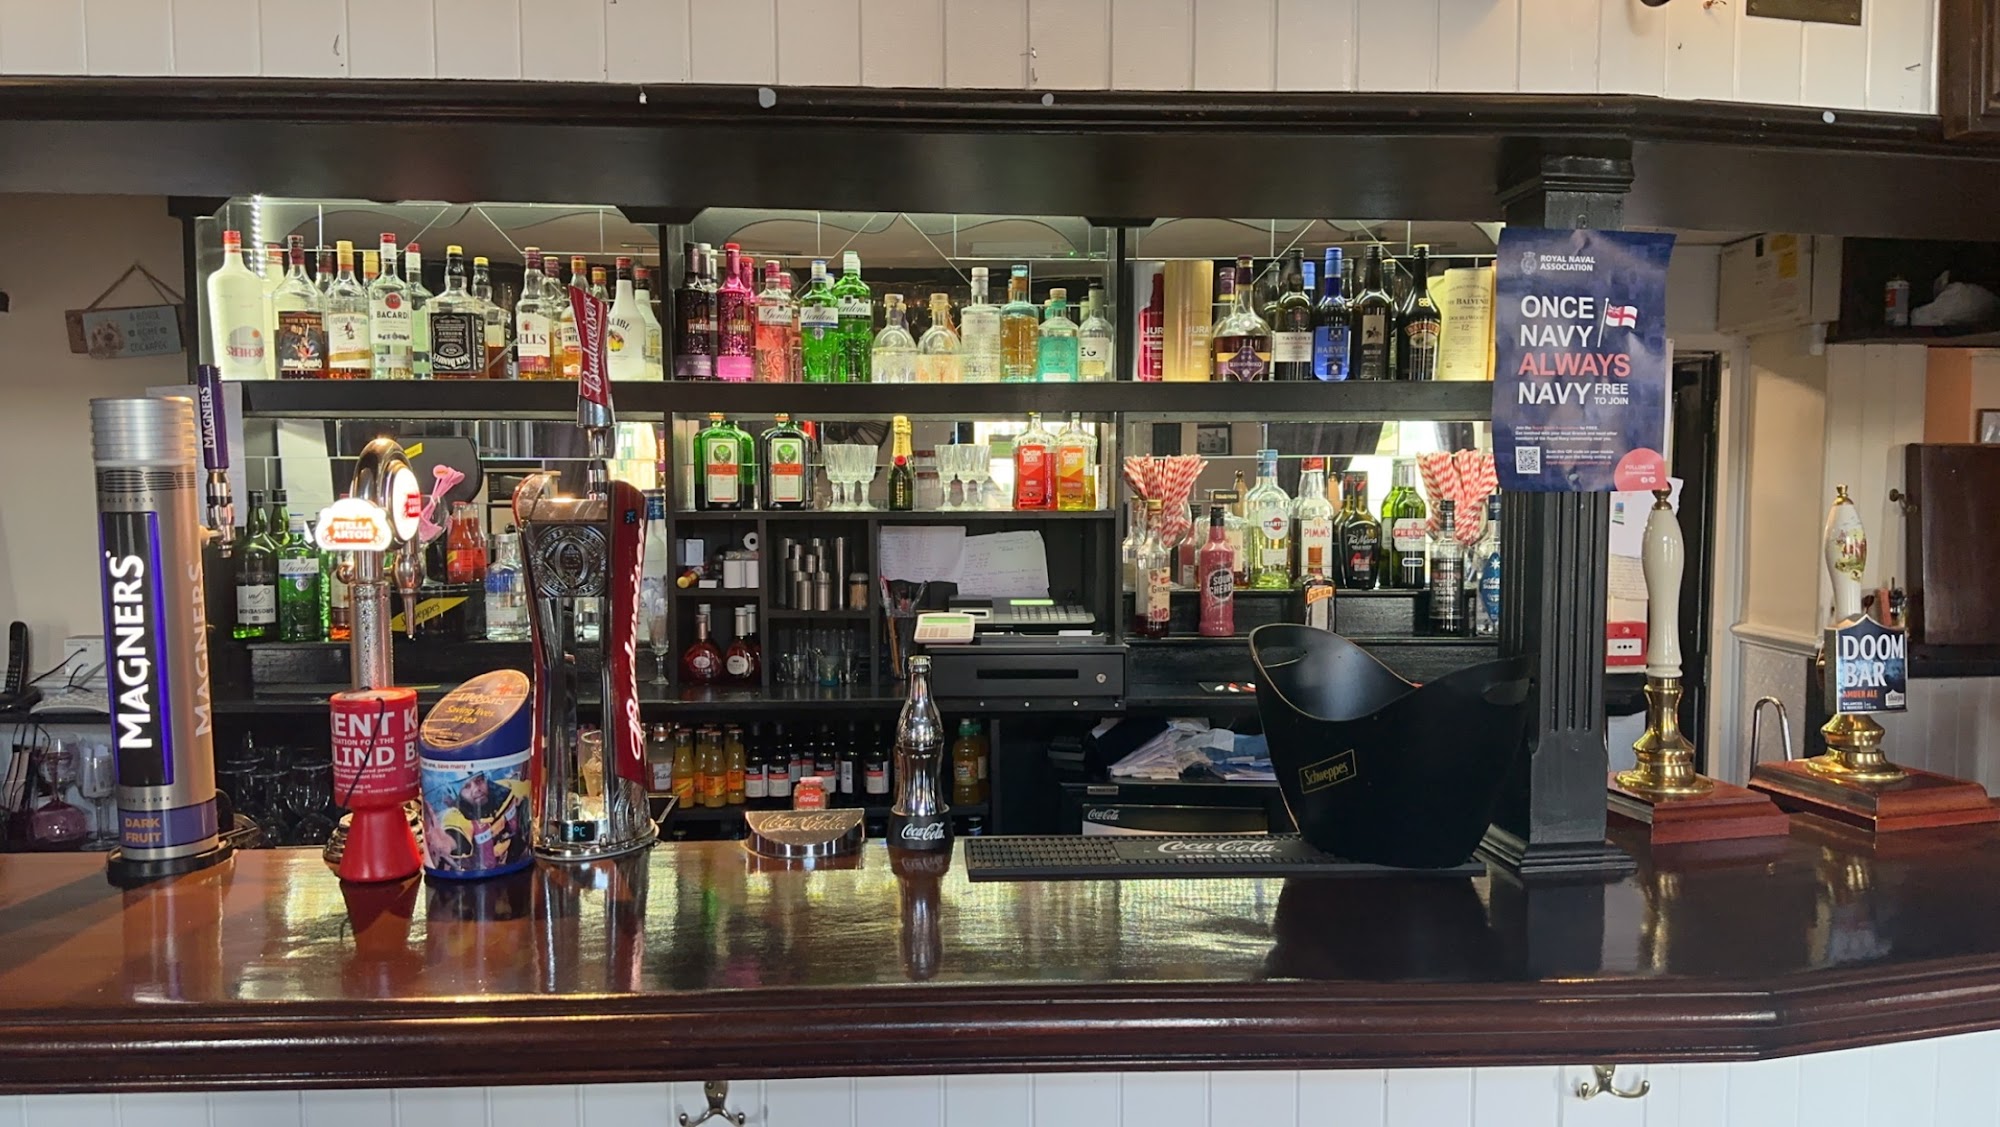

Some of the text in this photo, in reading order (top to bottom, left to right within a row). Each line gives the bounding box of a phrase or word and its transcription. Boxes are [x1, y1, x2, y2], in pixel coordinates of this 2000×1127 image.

[1540, 255, 1596, 264] ROYAL NAVAL
[1540, 263, 1594, 272] ASSOCIATION
[838, 302, 867, 313] ordon's
[1520, 295, 1594, 318] ONCE
[1144, 326, 1164, 335] JUR
[1520, 325, 1593, 347] NAVY
[519, 333, 547, 345] ELL'S
[582, 294, 602, 397] Budweiser
[1518, 353, 1631, 377] ALWAYS
[1518, 382, 1592, 404] NAVY
[1595, 383, 1629, 395] FREE
[1594, 396, 1629, 405] TO JOIN
[200, 387, 214, 449] MAGNERS
[332, 519, 373, 530] STELLA
[332, 530, 374, 540] ARTOIS
[1304, 527, 1331, 538] PIMM'S
[110, 554, 152, 749] MAGNERS
[187, 559, 211, 737] MAGNERS
[1842, 634, 1904, 660] DOOM
[1843, 661, 1887, 688] BAR
[1842, 689, 1878, 699] AMBER ALE
[447, 705, 496, 717] Saving lives
[334, 746, 396, 768] LIND
[1305, 762, 1349, 785] Schweppes
[1087, 808, 1120, 821] Coca-Cola
[125, 817, 161, 828] DARK
[760, 813, 846, 832] Coca-Cola
[125, 832, 162, 843] FRUIT
[901, 822, 945, 841] Coca-Cola
[1157, 840, 1279, 853] Coca-Cola
